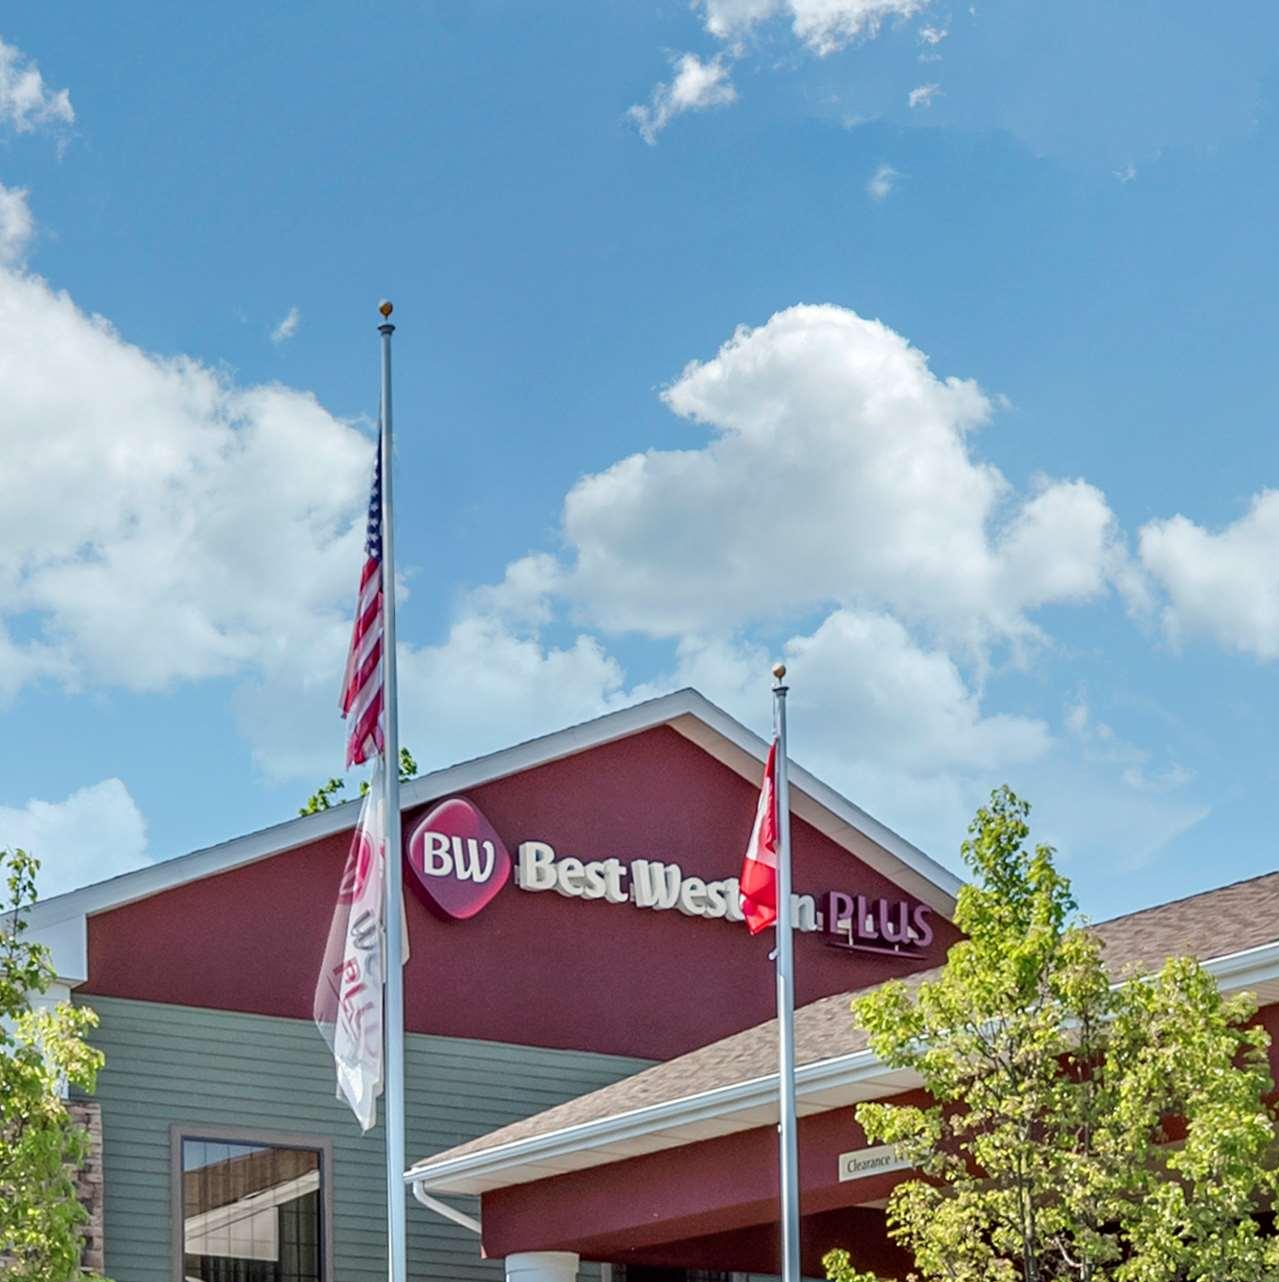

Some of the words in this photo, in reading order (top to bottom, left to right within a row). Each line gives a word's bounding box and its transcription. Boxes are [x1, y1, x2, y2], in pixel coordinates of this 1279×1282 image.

[424, 832, 495, 883] BW
[519, 841, 629, 903] Best
[630, 859, 818, 931] Westn
[830, 890, 934, 946] PLUS
[847, 1155, 890, 1173] Clearance
